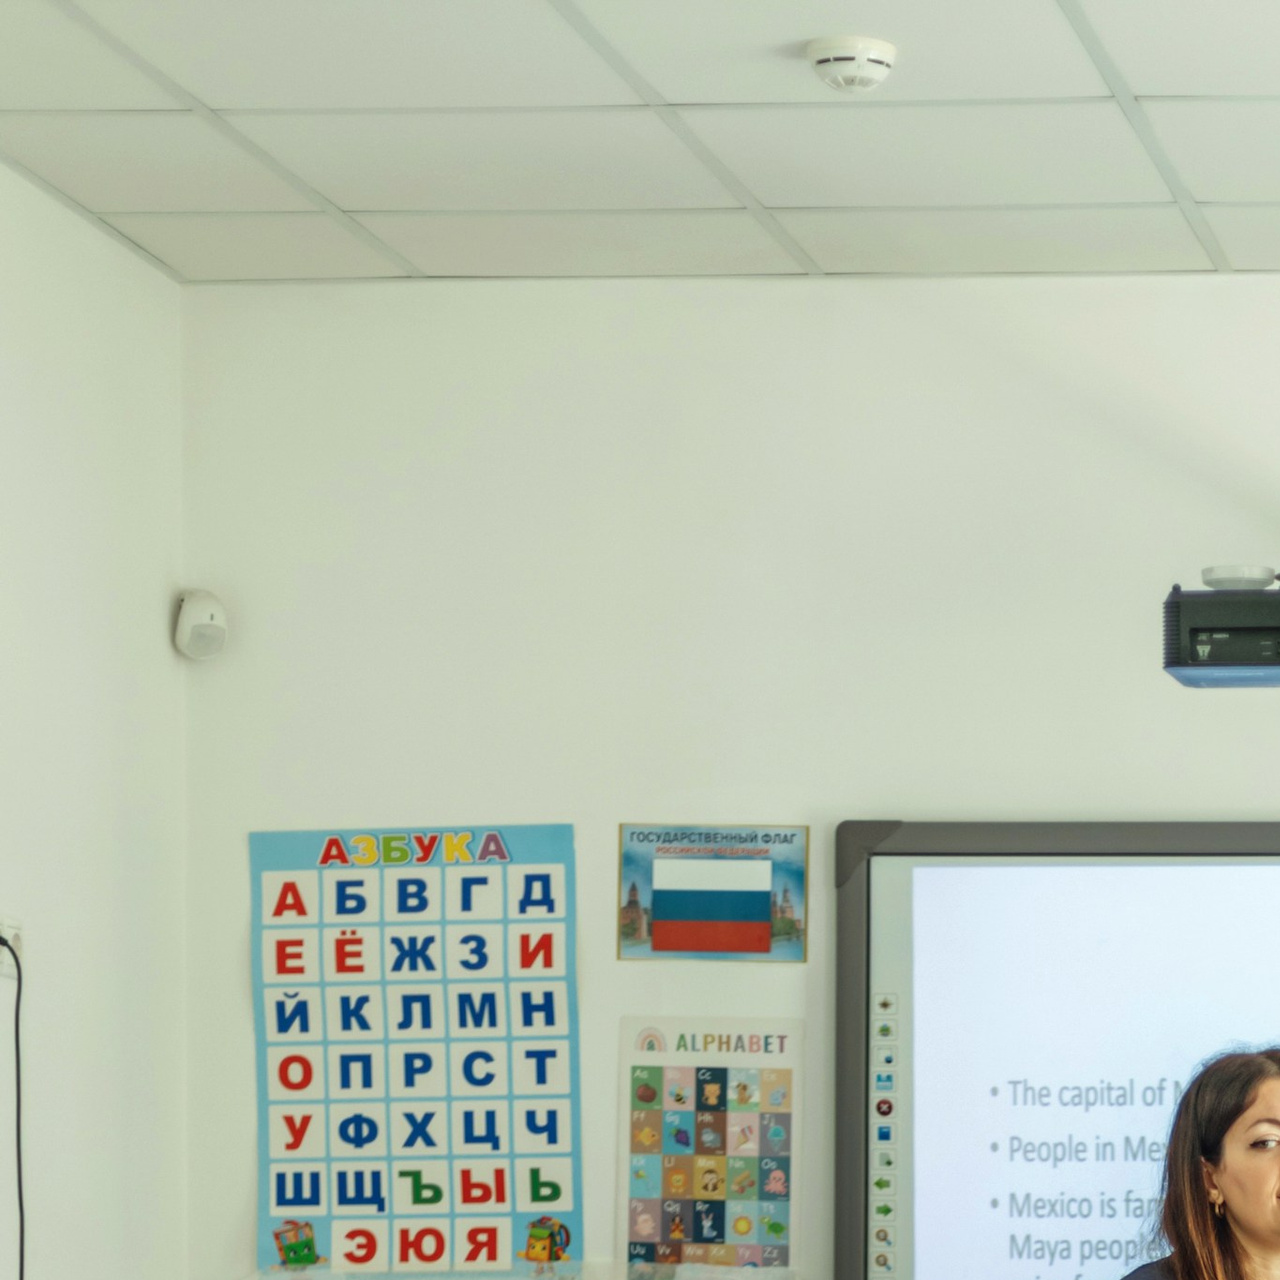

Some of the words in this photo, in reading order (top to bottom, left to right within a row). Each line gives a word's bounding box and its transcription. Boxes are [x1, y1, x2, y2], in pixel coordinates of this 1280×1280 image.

[319, 832, 509, 866] АЗБУКА
[630, 831, 757, 844] ГОСУДАРСТВЕННЫЙ
[761, 833, 796, 844] ФЛАГ
[273, 882, 307, 916] А
[336, 880, 366, 915] Б
[397, 879, 428, 913] В
[461, 877, 488, 911] Г
[519, 874, 554, 914] Д
[276, 940, 304, 974] Е
[335, 930, 364, 973] Ё
[391, 936, 435, 971] Ж
[460, 935, 488, 970] З
[520, 934, 552, 968] И
[276, 993, 309, 1033] Й
[340, 996, 371, 1031] К
[398, 994, 431, 1030] Л
[458, 993, 497, 1028] М
[521, 991, 555, 1027] Н
[676, 1033, 788, 1053] ALPHABET
[279, 1055, 312, 1090] О
[340, 1054, 372, 1089] П
[404, 1053, 432, 1087] Р
[463, 1051, 495, 1086] С
[525, 1050, 556, 1085] Т
[1008, 1079, 1051, 1106] The
[1058, 1079, 1134, 1112] capital
[1143, 1078, 1166, 1106] of
[283, 1115, 312, 1150] У
[339, 1114, 378, 1148] Ф
[403, 1112, 436, 1147] Х
[464, 1110, 500, 1150] Ц
[526, 1110, 557, 1144] Ч
[1009, 1135, 1087, 1168] People
[1096, 1136, 1115, 1162] in
[276, 1172, 320, 1206] Ш
[337, 1171, 385, 1212] Щ
[399, 1170, 443, 1204] Ъ
[461, 1169, 505, 1204] Ы
[530, 1168, 561, 1202] Ь
[1009, 1192, 1092, 1218] Mexico
[1100, 1192, 1116, 1218] is
[344, 1229, 377, 1264] Э
[400, 1228, 445, 1262] Ю
[465, 1227, 497, 1261] Я
[1009, 1234, 1071, 1266] Maya
